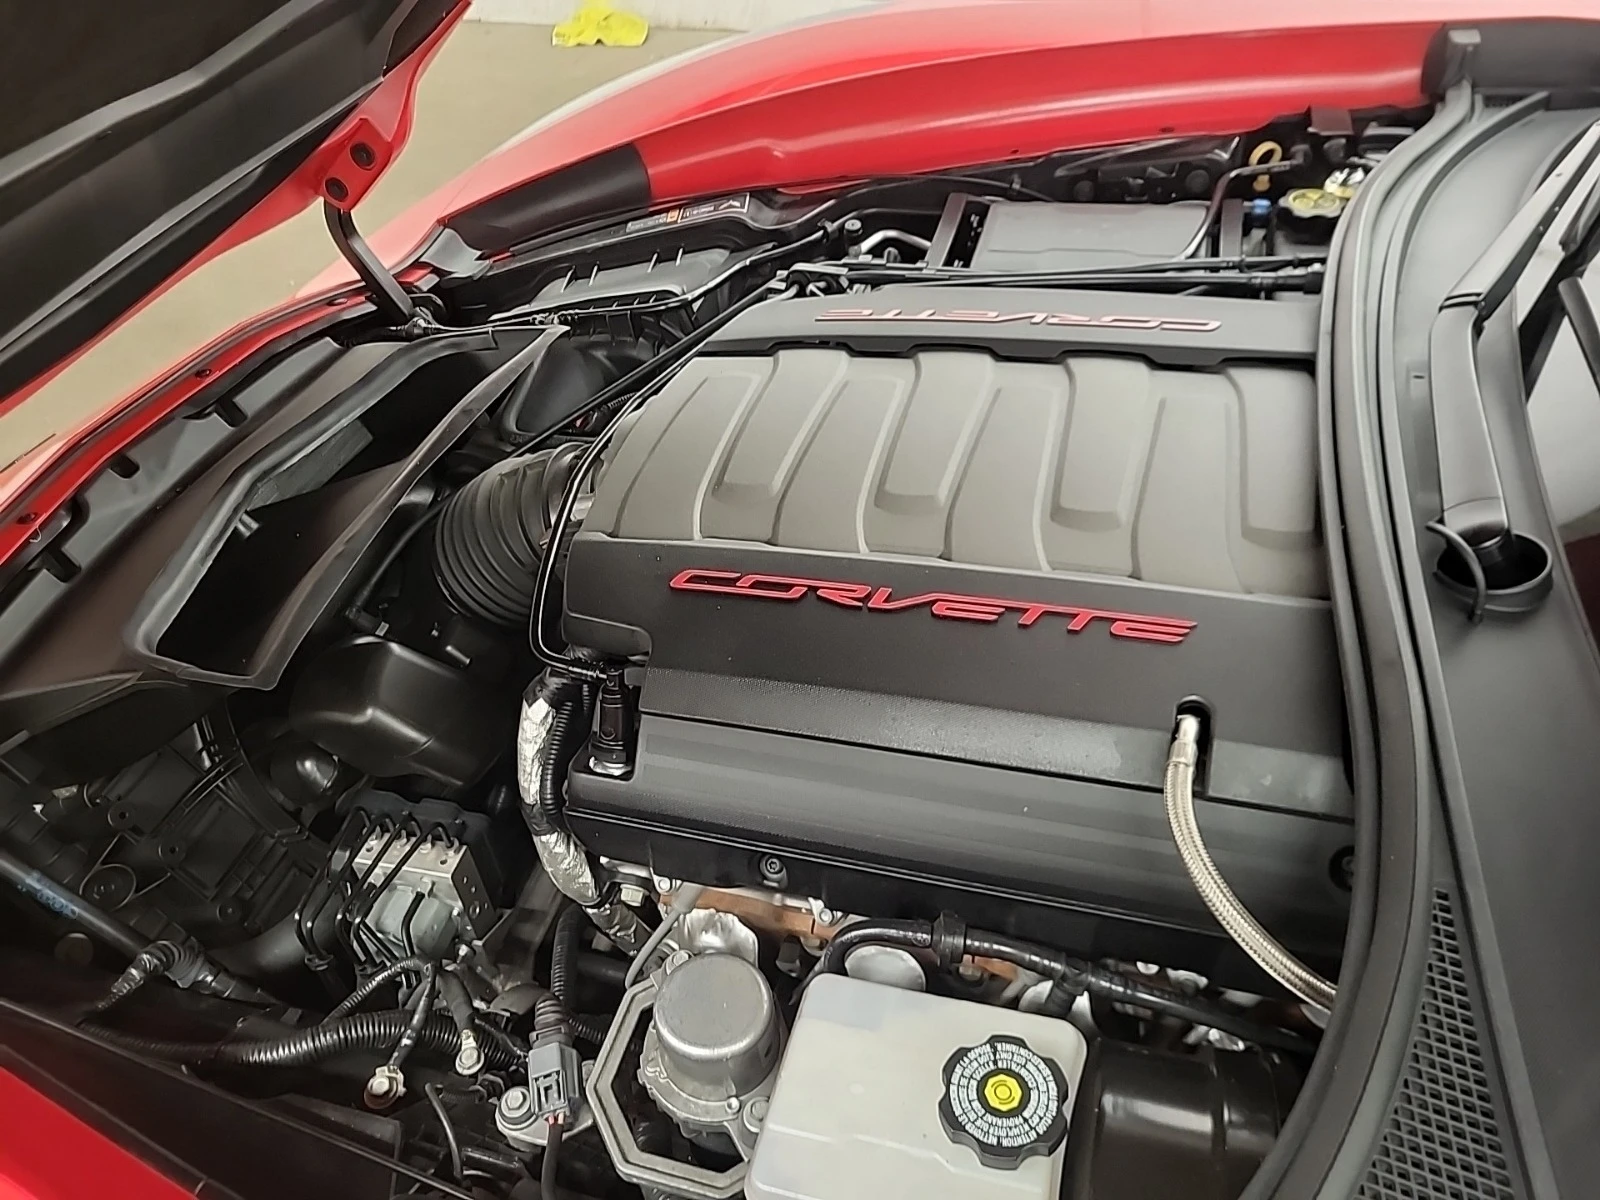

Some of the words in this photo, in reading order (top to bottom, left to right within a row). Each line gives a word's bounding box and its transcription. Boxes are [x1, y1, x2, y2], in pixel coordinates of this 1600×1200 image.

[814, 308, 1222, 333] CORVETTE
[669, 568, 1198, 645] CORVETTE
[993, 1051, 1013, 1060] ONLY
[981, 1113, 1025, 1128] PROVENANT
